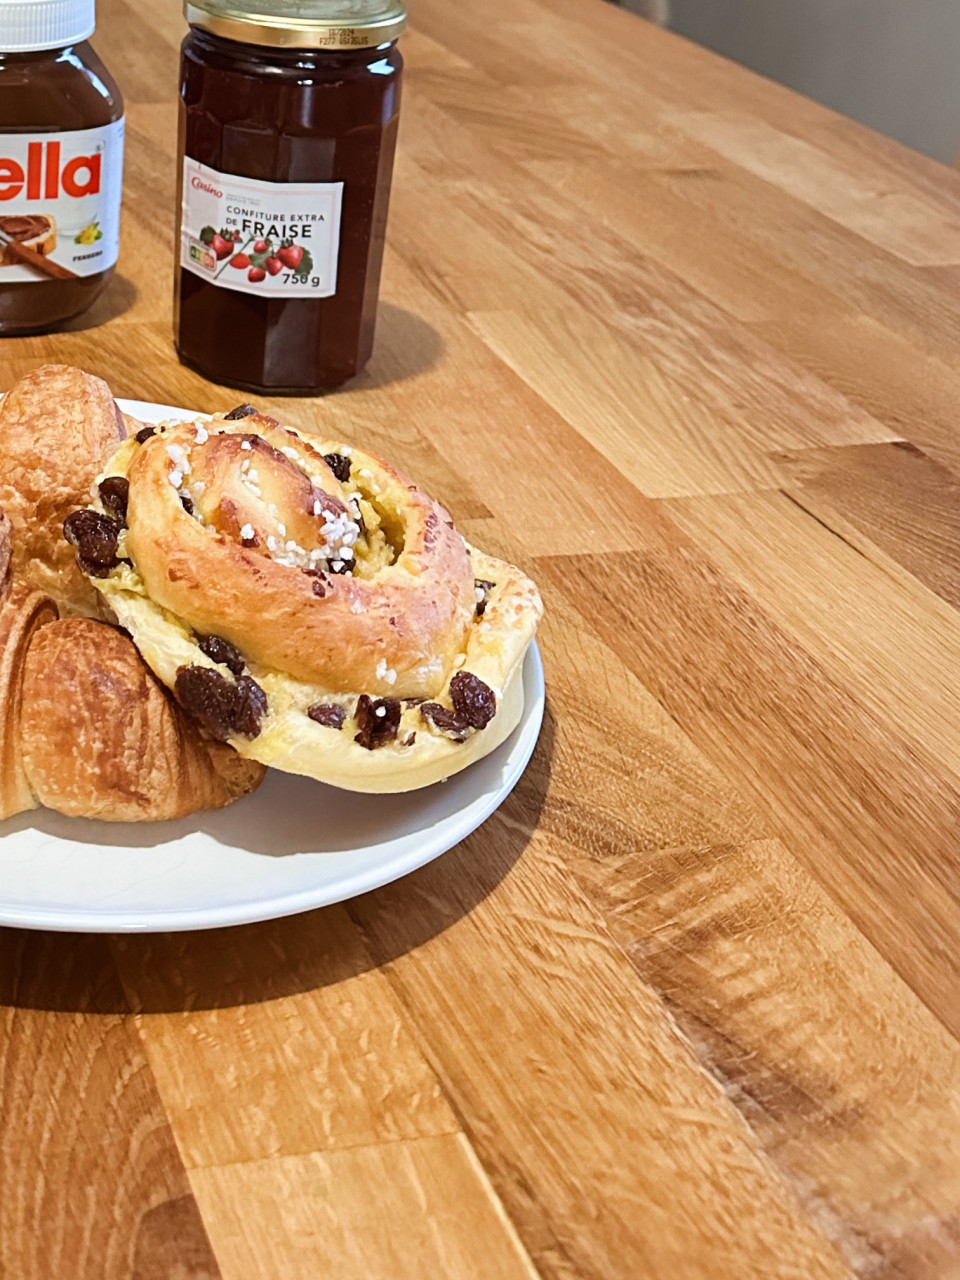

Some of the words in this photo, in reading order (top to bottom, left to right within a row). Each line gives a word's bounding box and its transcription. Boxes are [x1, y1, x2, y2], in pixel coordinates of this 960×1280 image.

[191, 176, 224, 199] Casino
[226, 205, 286, 222] CONFITURE
[290, 214, 325, 222] EXTRA
[226, 217, 238, 226] DE
[242, 219, 312, 238] FRAISE
[282, 273, 308, 285] 750
[311, 276, 320, 288] g
